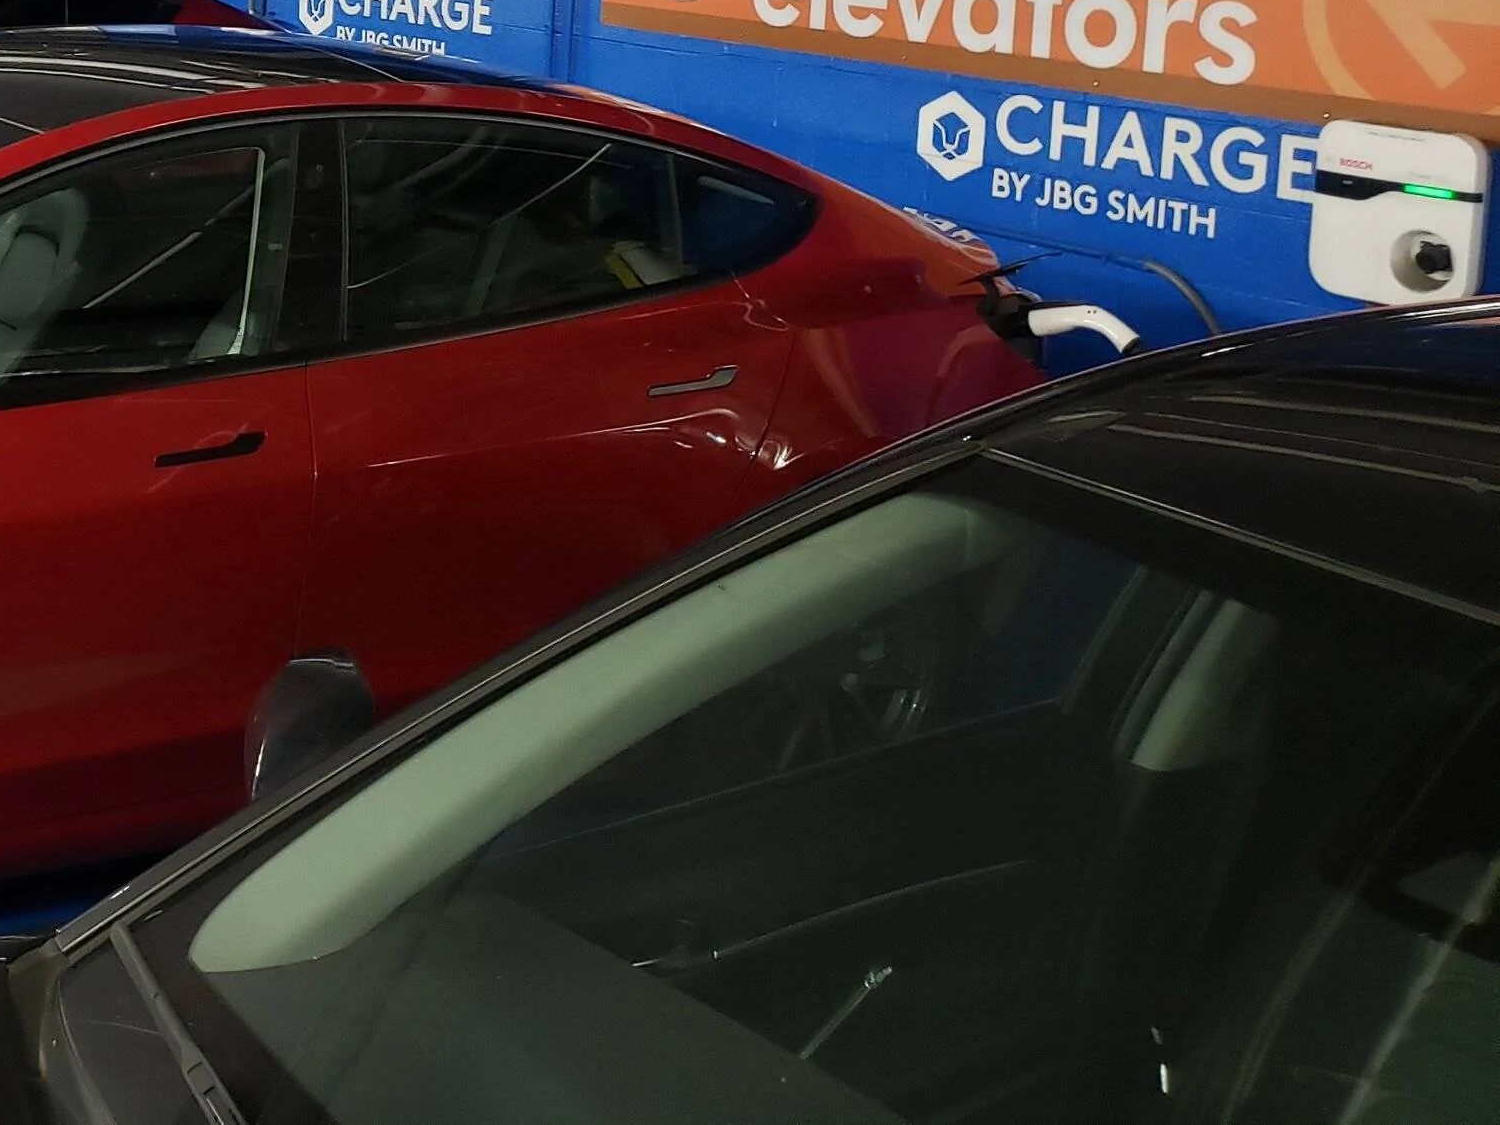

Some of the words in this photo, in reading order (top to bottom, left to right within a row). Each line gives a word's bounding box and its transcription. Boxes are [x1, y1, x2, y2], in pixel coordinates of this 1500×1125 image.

[995, 93, 1318, 205] CHARGE
[1339, 157, 1373, 172] BOSCH
[991, 167, 1031, 203] BY
[1035, 176, 1099, 216] JBG
[1106, 190, 1218, 240] SMITH
